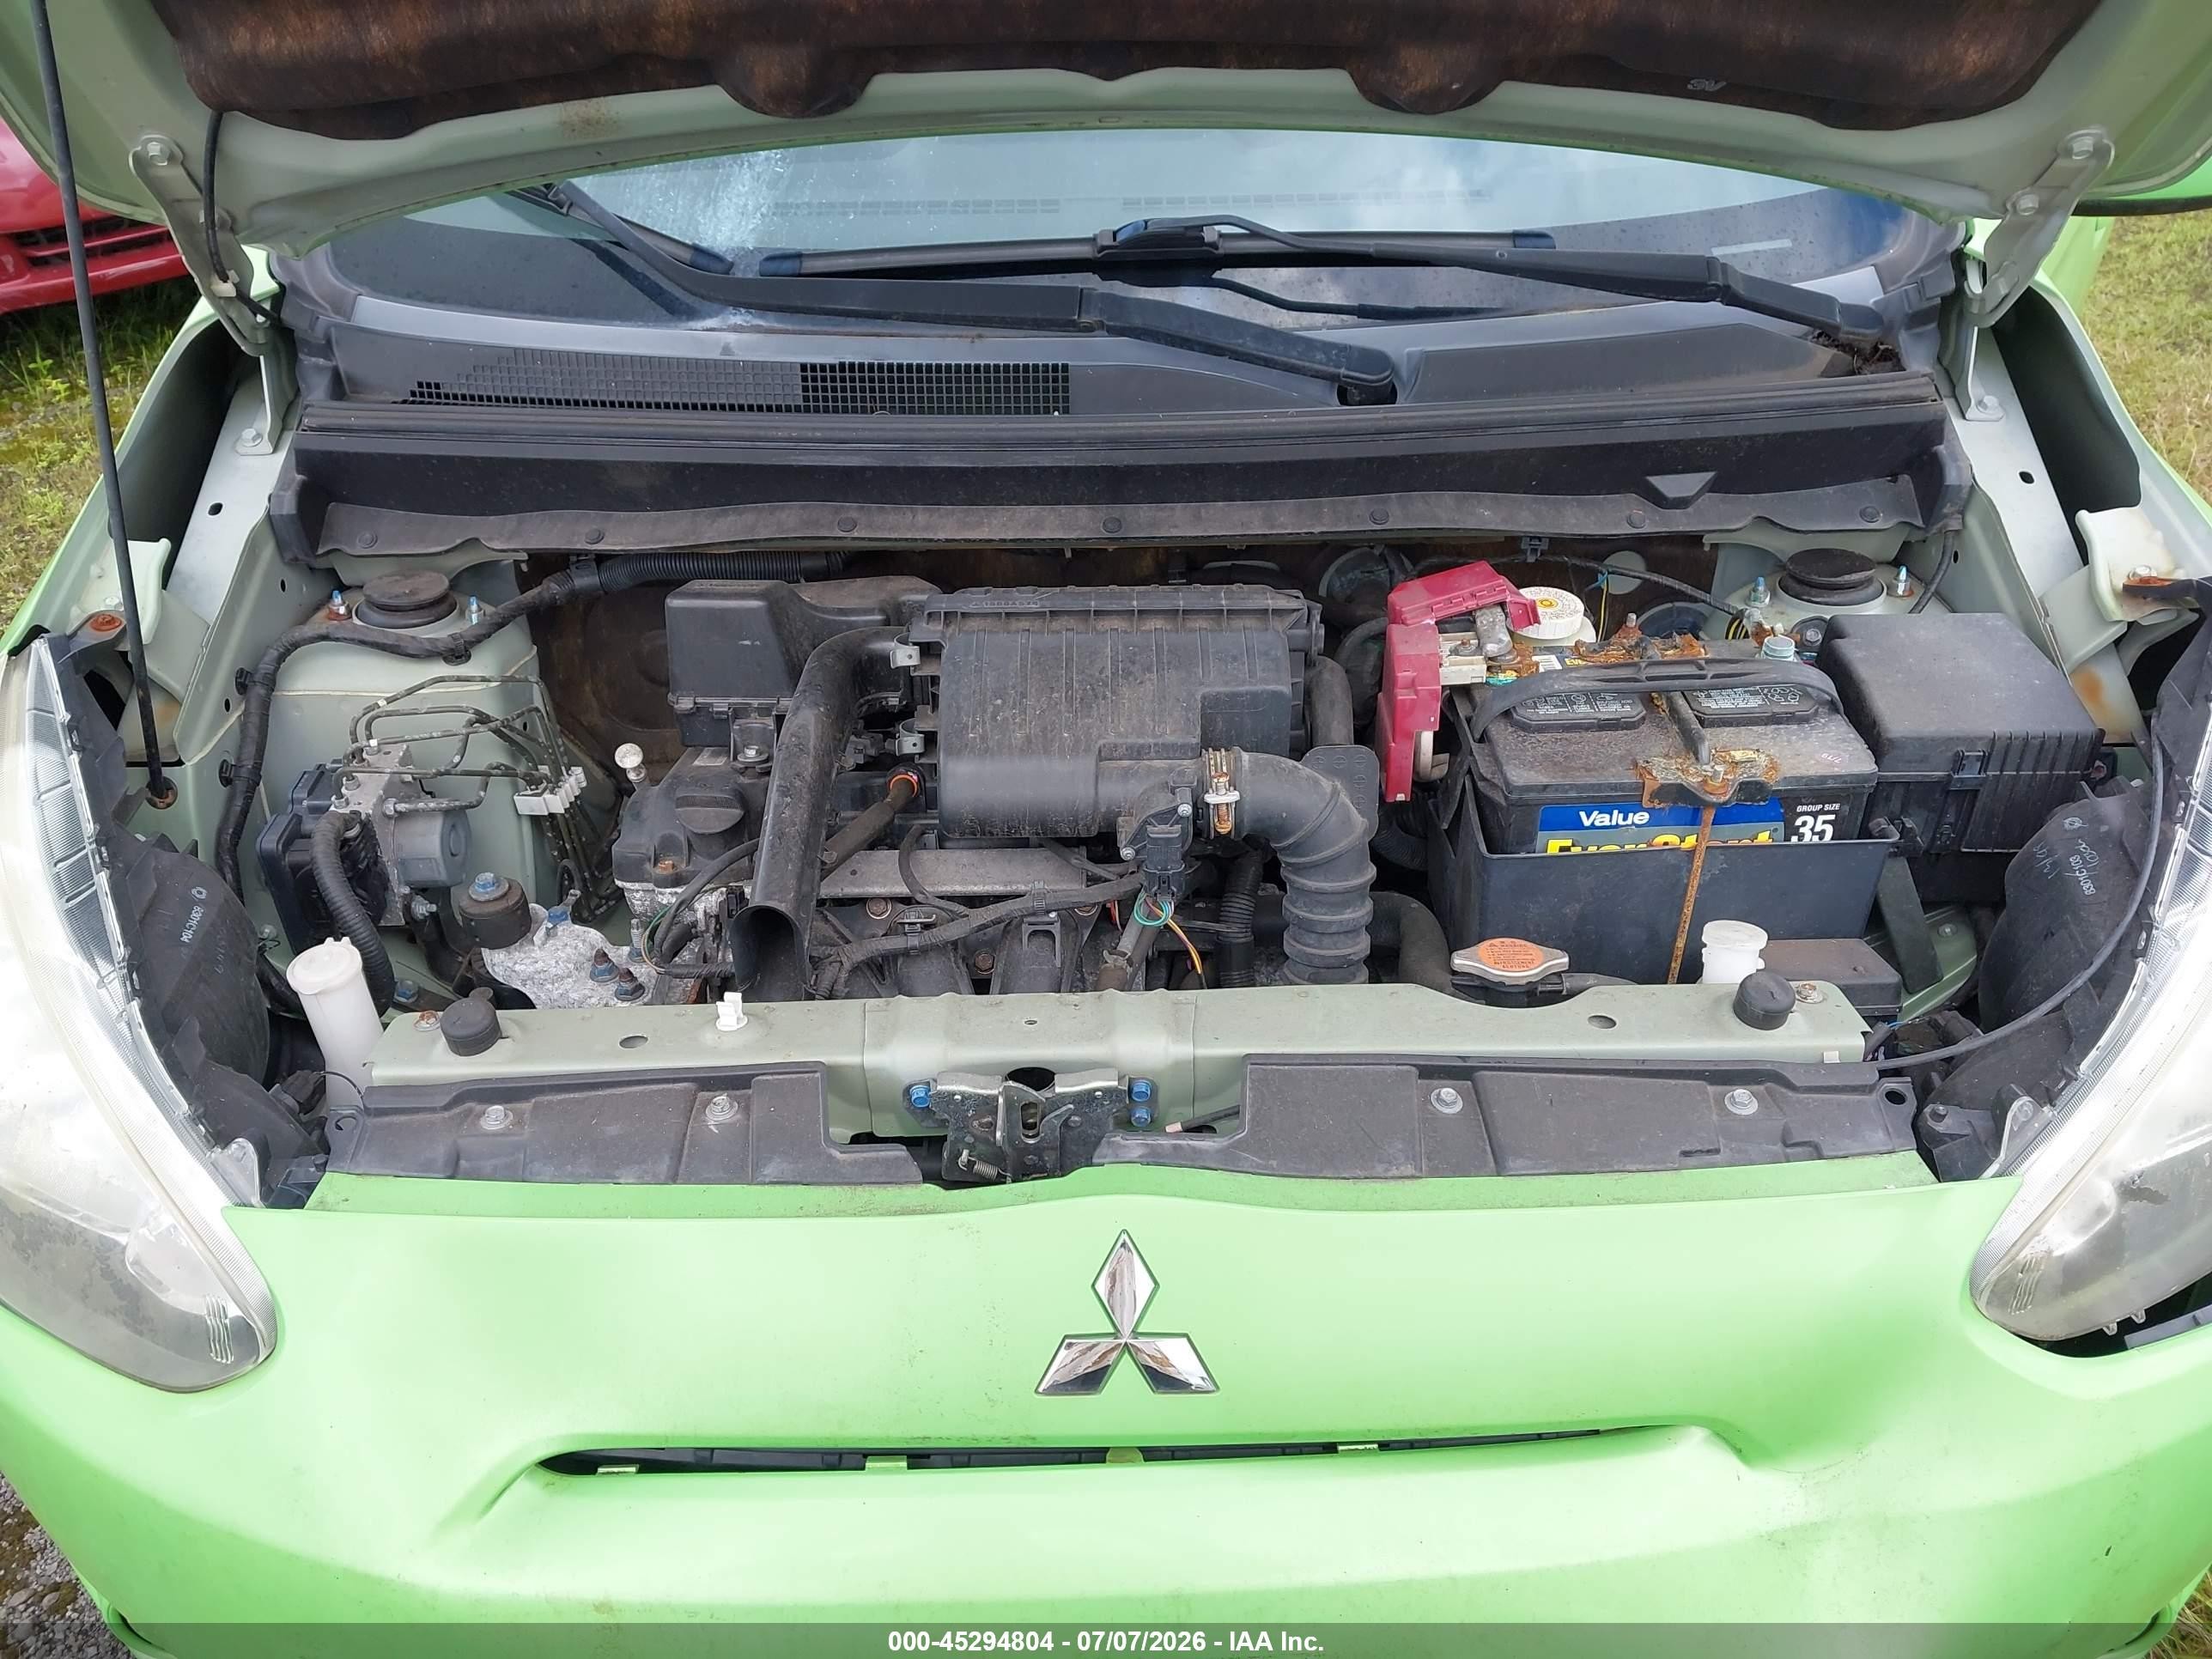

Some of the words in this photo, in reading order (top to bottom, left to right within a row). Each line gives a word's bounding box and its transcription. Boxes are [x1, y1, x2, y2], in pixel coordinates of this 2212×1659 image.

[1796, 804, 1823, 812] GROUP
[1824, 803, 1840, 811] SIZE
[1579, 809, 1650, 827] Value
[1790, 814, 1836, 842] 35
